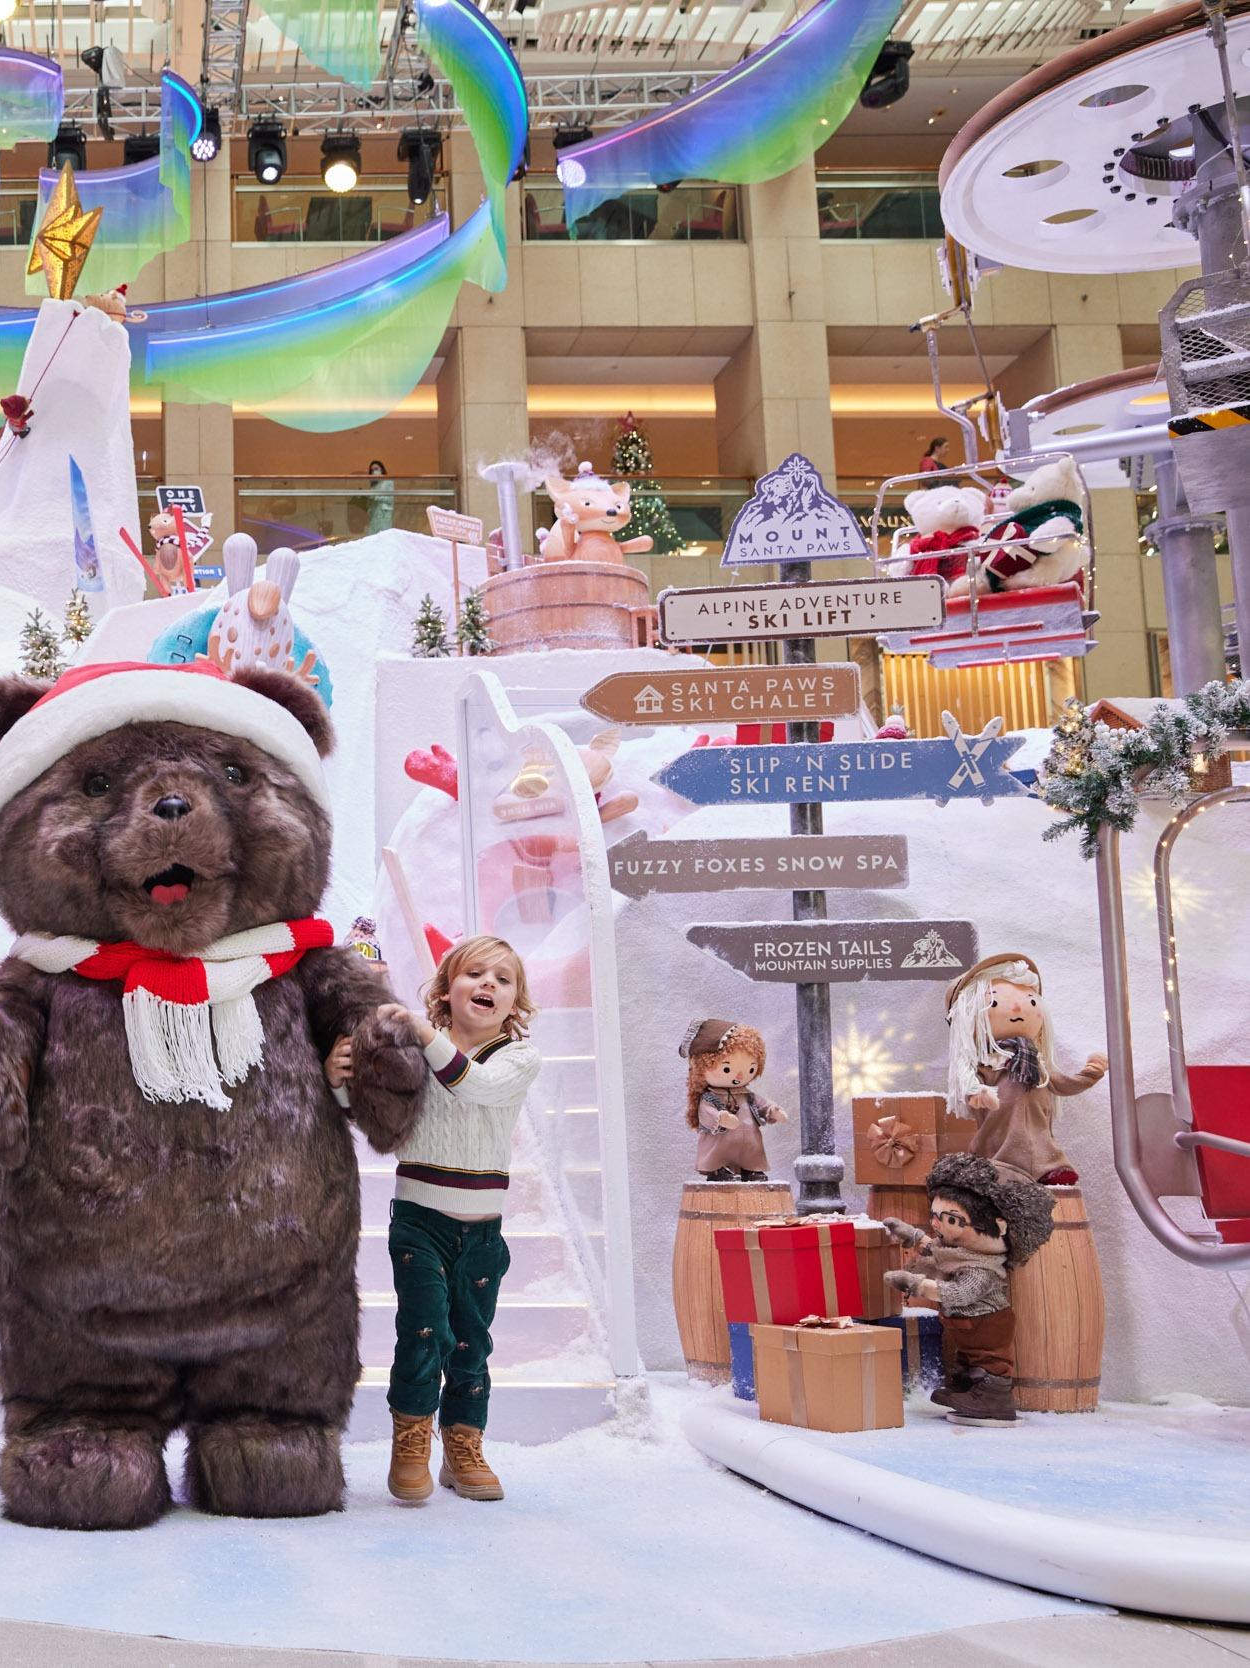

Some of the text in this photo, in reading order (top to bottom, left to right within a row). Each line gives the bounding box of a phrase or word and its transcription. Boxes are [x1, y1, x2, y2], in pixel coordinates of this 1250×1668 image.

[166, 490, 195, 498] ONE
[739, 526, 850, 544] MOUNT
[740, 541, 850, 557] SANTA PAWS
[698, 591, 903, 615] ALPINE ADVENTURE
[748, 610, 851, 630] SKI LIFT
[671, 676, 835, 696] SANTA PAWS
[671, 692, 835, 712] SKI CHALET
[730, 757, 789, 775] SLIP
[839, 752, 913, 771] SLIDE
[731, 775, 851, 795] SKI RENT
[614, 855, 899, 875] FUZZY FOXES SNOW SPA
[754, 939, 892, 957] FROZEN TAILS
[755, 957, 892, 972] MOUNTAIN SUPPLIES
